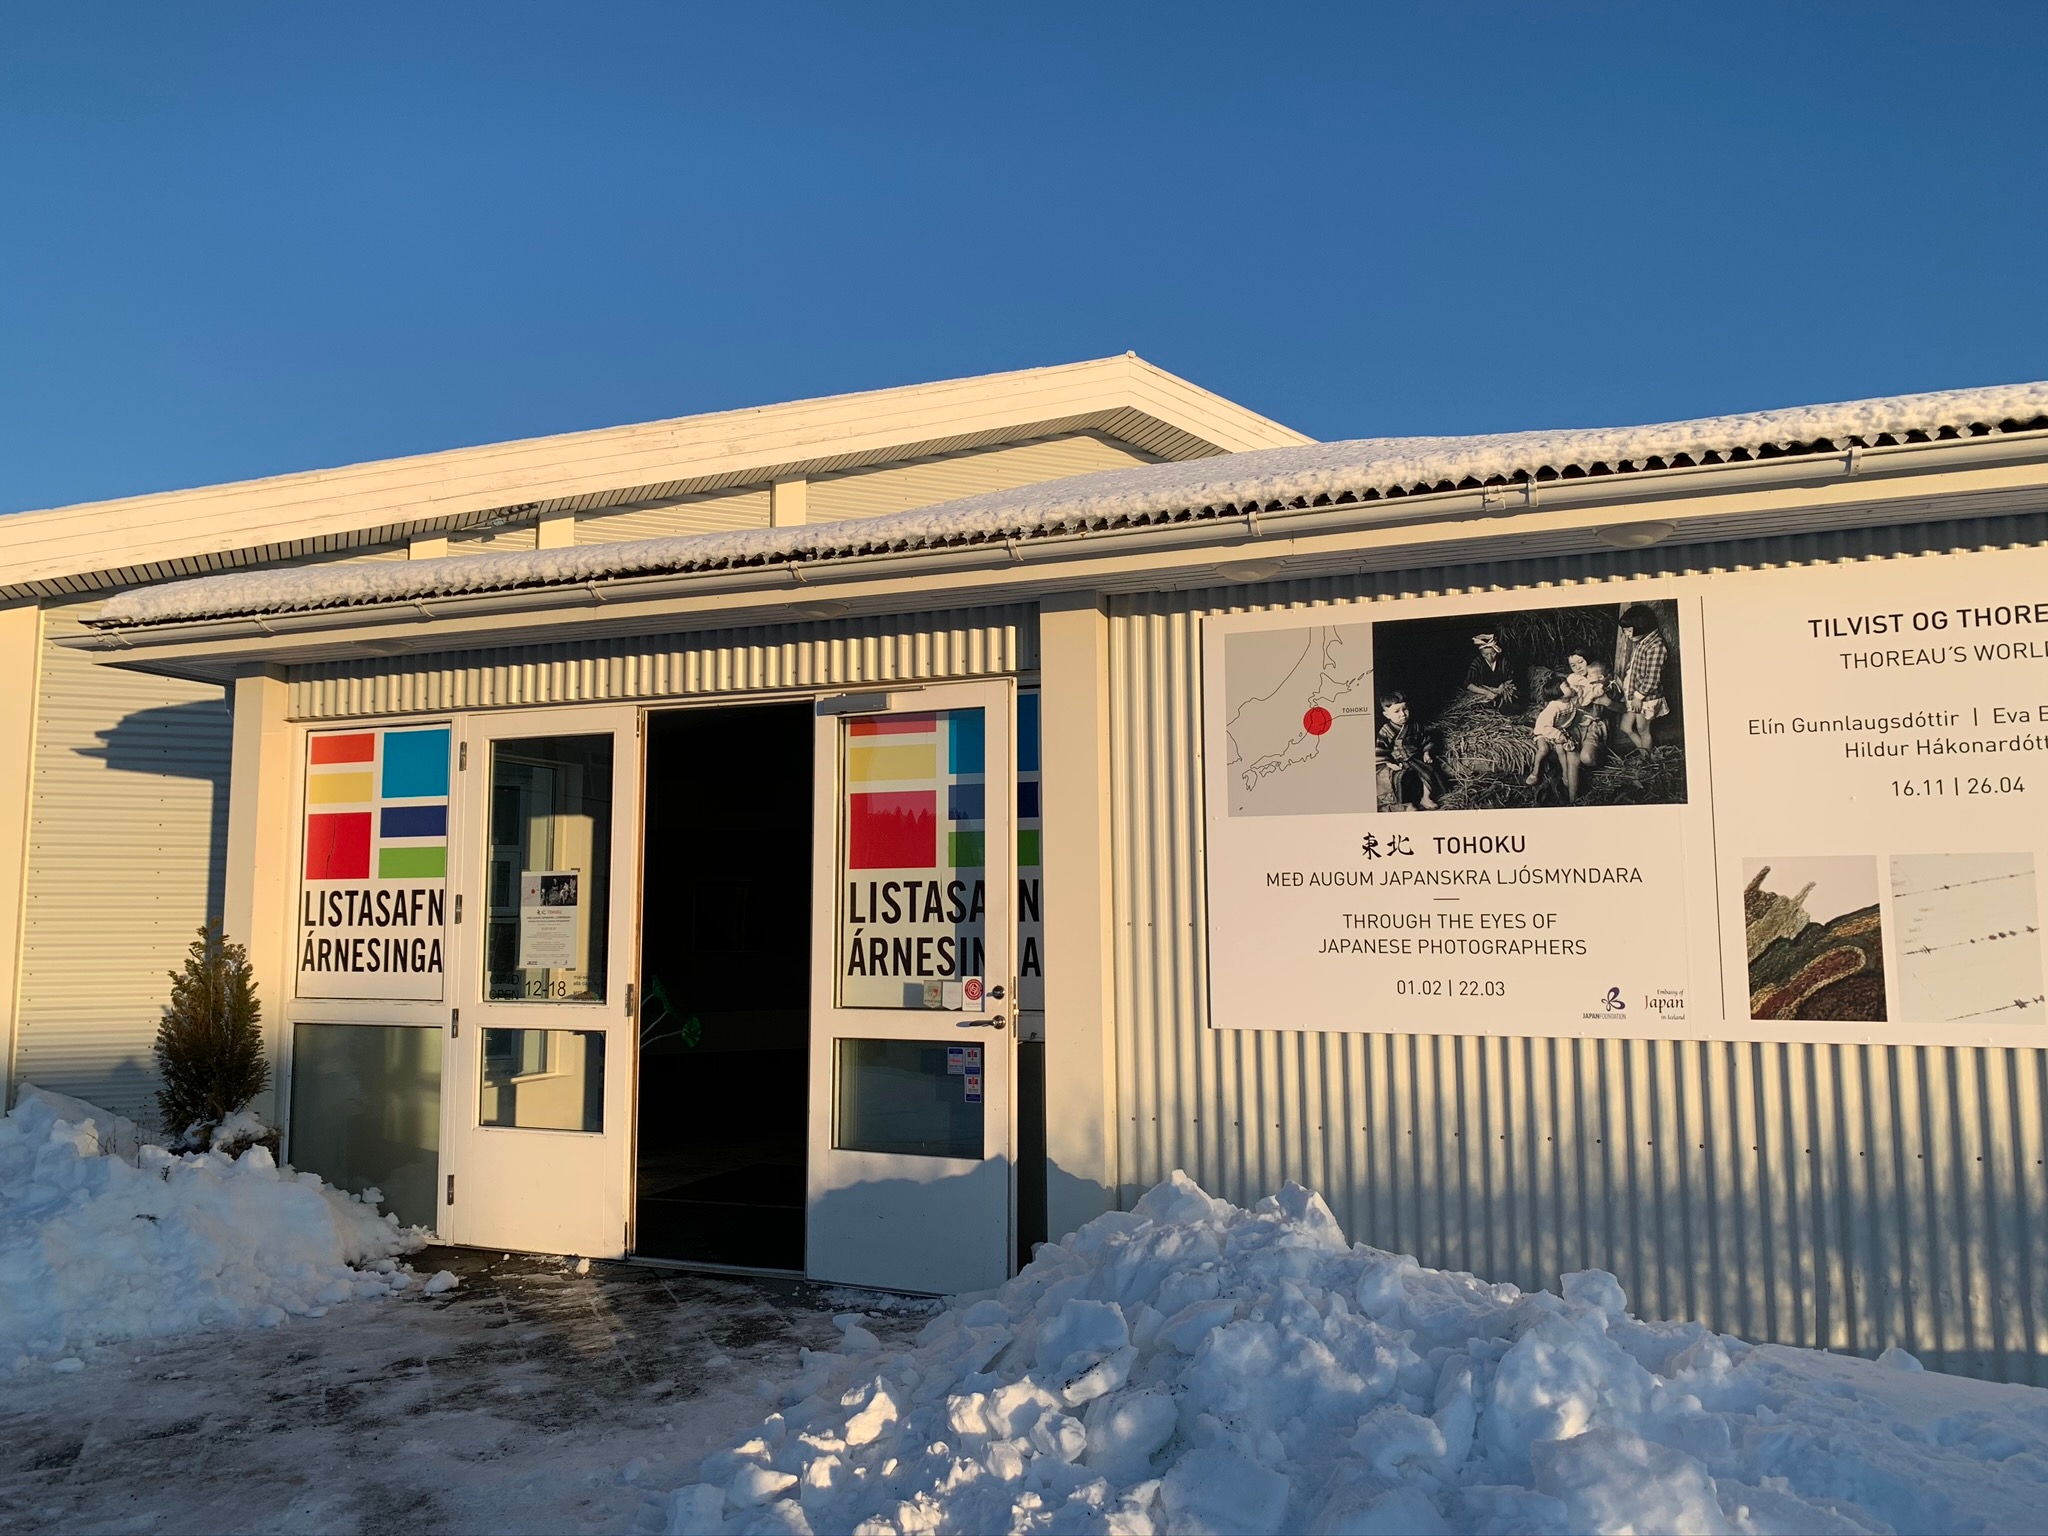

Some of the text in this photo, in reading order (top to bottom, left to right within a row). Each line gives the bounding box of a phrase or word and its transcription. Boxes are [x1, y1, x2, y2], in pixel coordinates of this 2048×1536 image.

[1808, 604, 2048, 637] TILVIST OG THORE
[1974, 641, 2048, 661] WORL
[1749, 719, 1784, 734] Elín
[1793, 711, 1959, 733] Gunnlaugsdóttir
[1994, 708, 2029, 723] Eva
[1846, 742, 1909, 757] Hildur
[1892, 780, 1942, 796] 16.11
[1968, 777, 2024, 794] 26.04
[1362, 832, 1525, 860] 東北 TOHOKU
[1267, 865, 1642, 886] MEÐ AUGUM JAPANSKRA LJÓSMYNDARA
[305, 889, 444, 927] LISTASAFN
[1343, 914, 1557, 928] THROUGH THE EYES OF
[302, 931, 442, 973] ÁRNESINGA
[1319, 939, 1586, 955] JAPANESE PHOTOGRAPHERS
[489, 990, 519, 1000] OPEN
[525, 980, 566, 997] 12-18
[1397, 980, 1441, 995] 01.02
[1460, 981, 1504, 996] 22.03
[1645, 996, 1684, 1013] Japan
